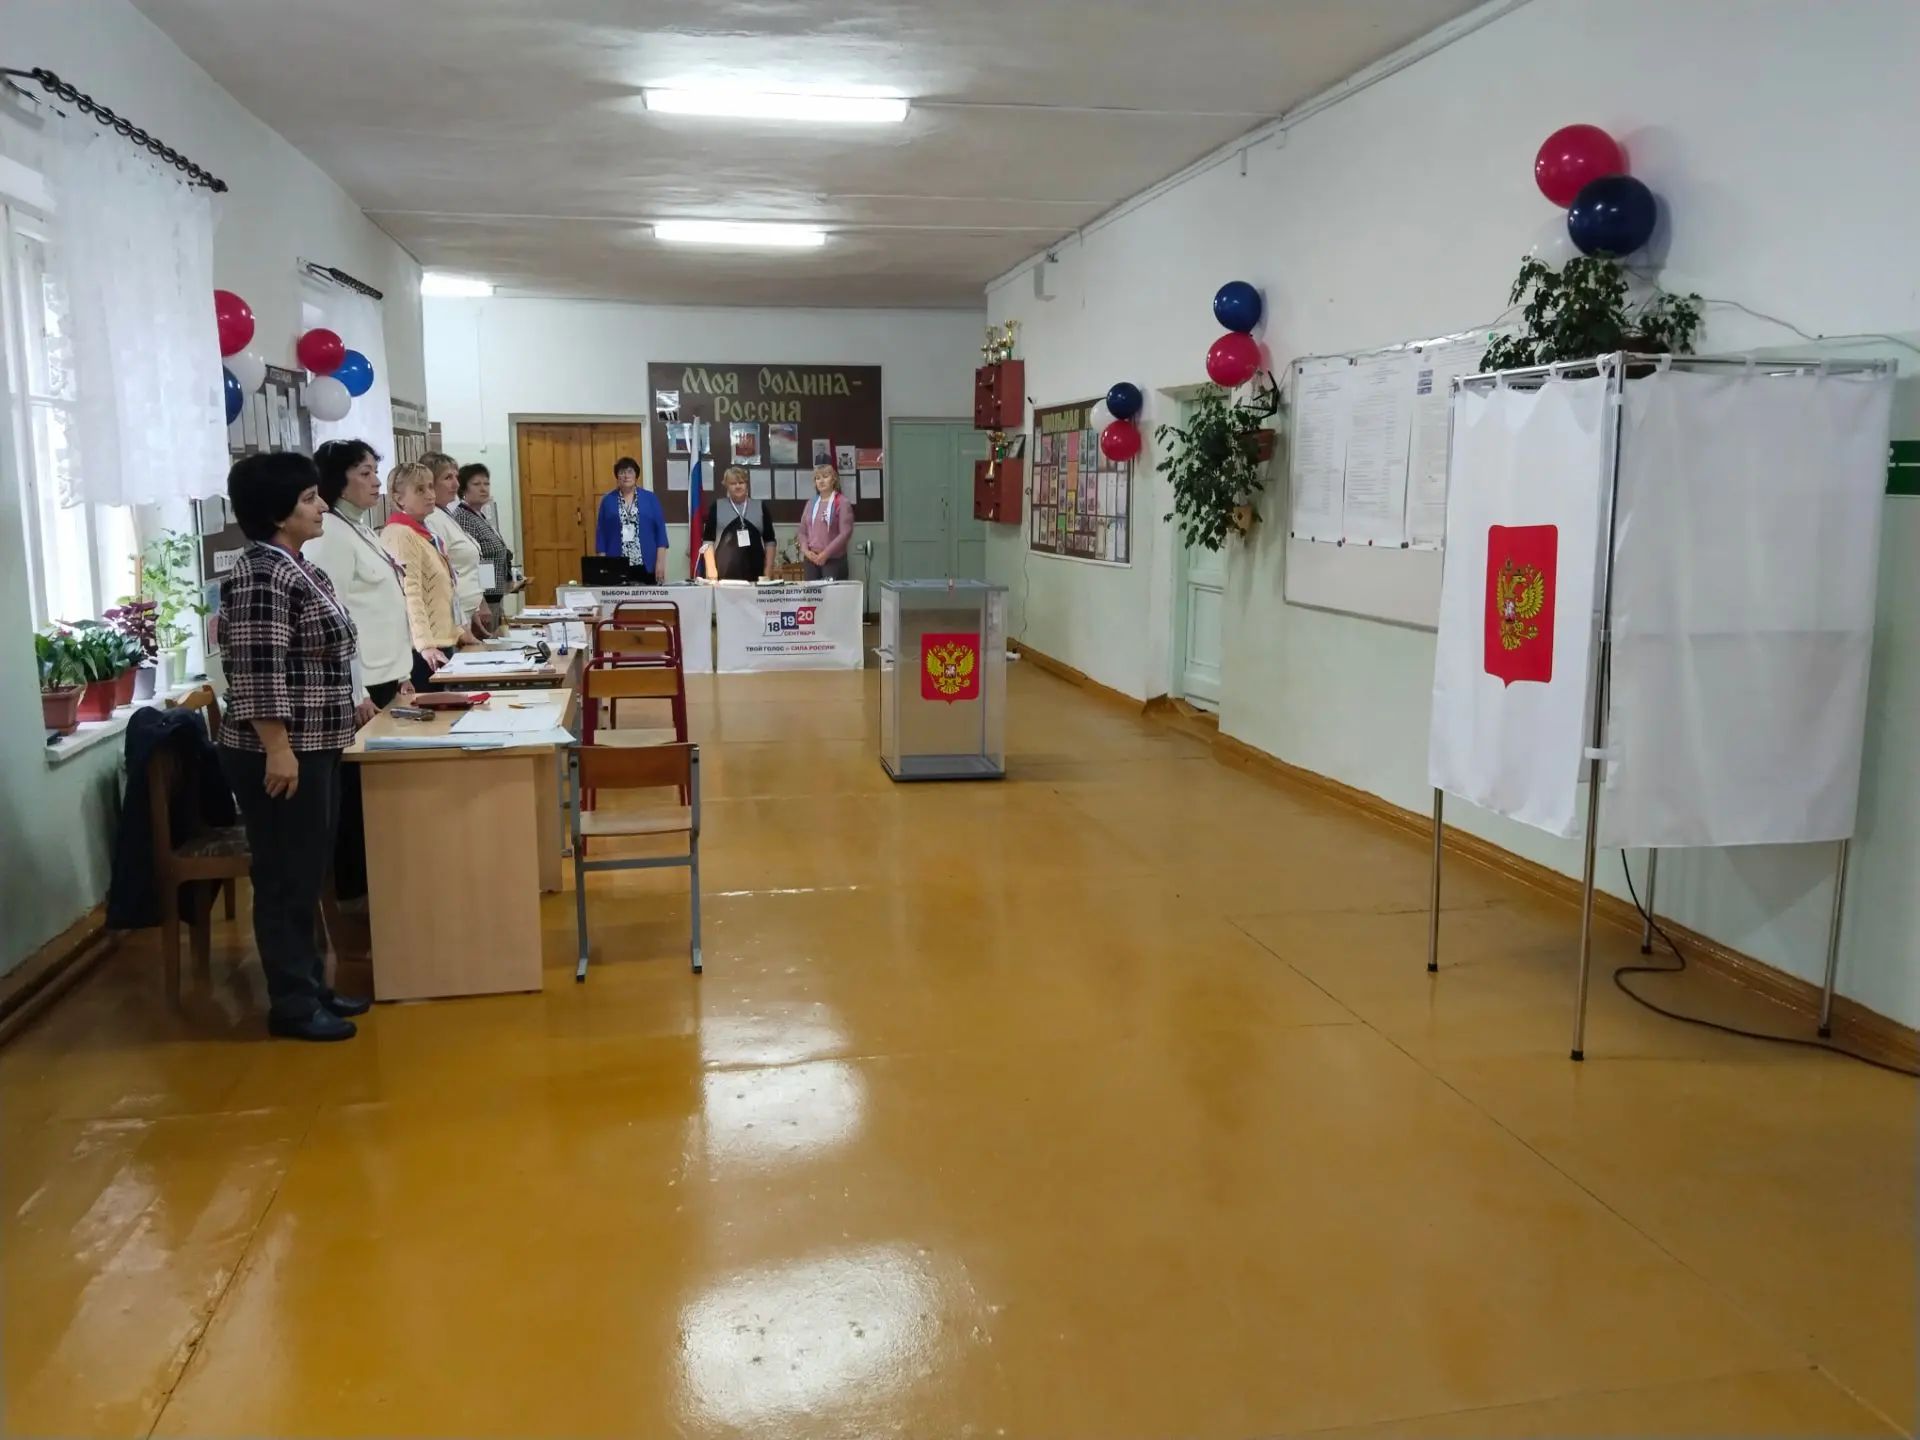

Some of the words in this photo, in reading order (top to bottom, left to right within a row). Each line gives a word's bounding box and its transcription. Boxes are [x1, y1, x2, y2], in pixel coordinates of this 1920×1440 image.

[767, 621, 780, 633] 18
[782, 615, 795, 627] 19
[797, 610, 813, 621] 20
